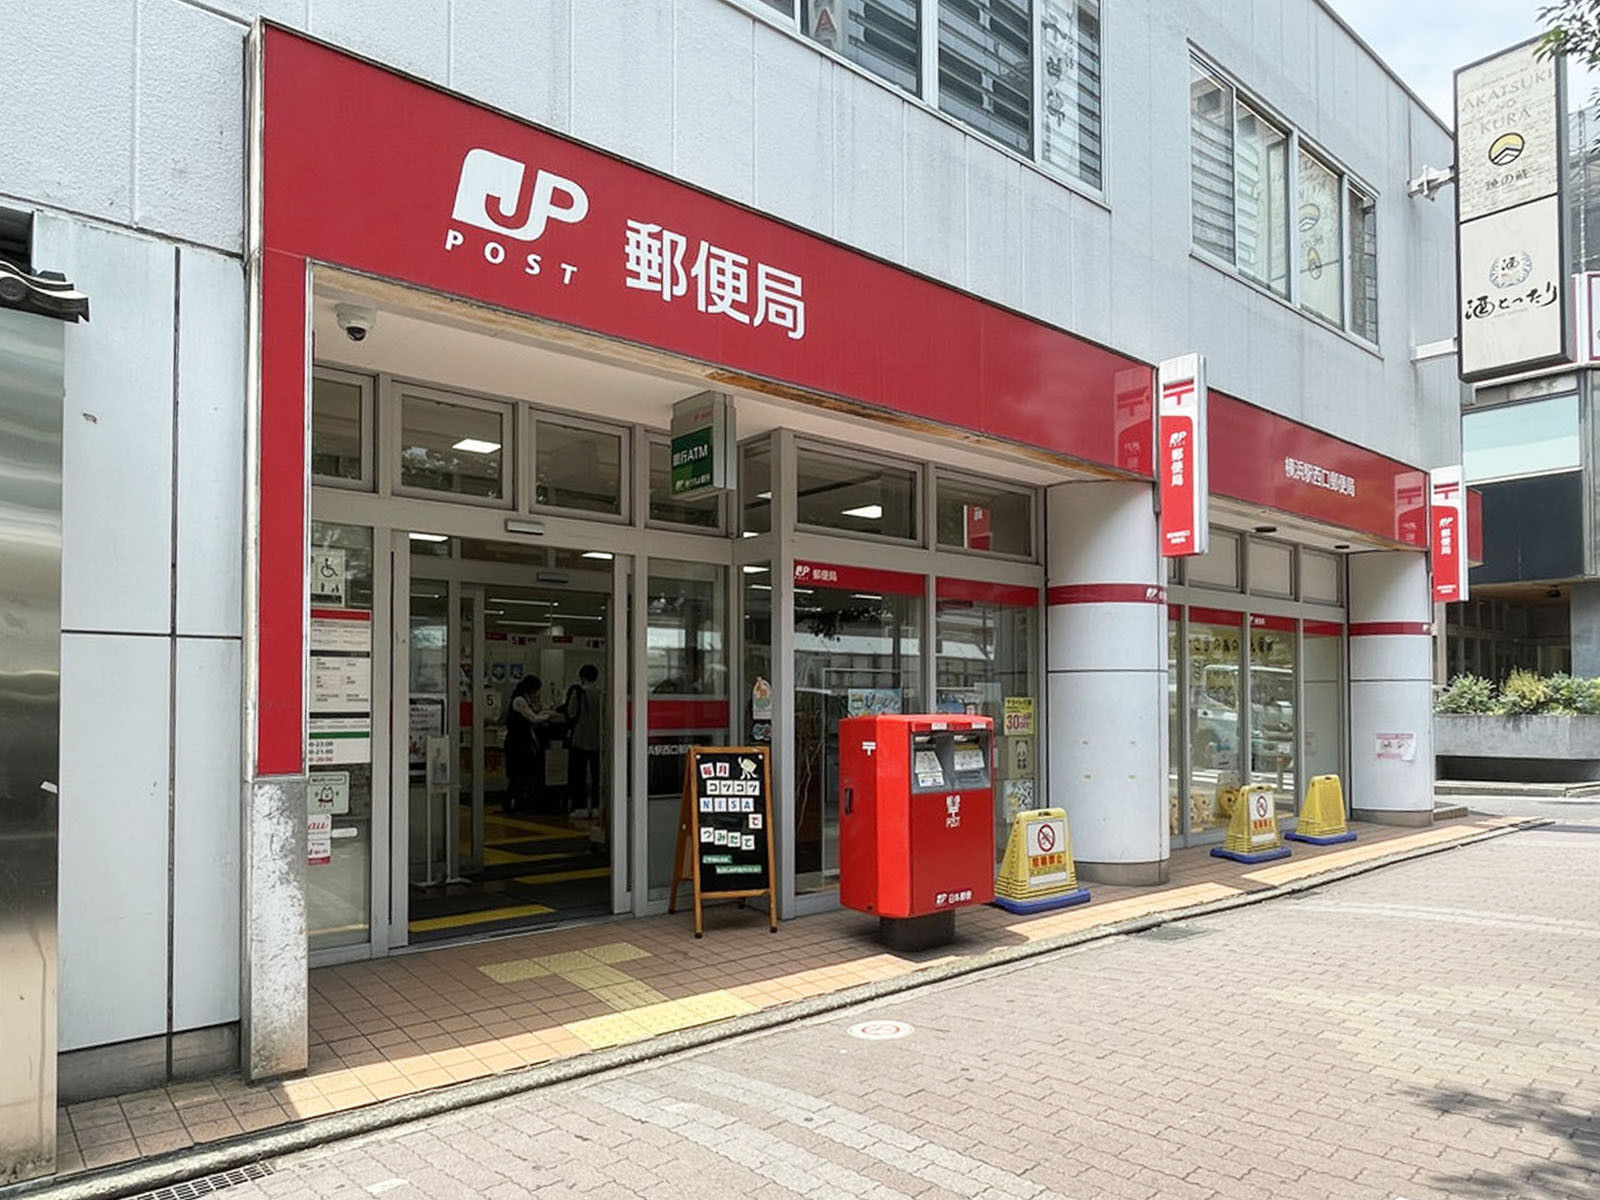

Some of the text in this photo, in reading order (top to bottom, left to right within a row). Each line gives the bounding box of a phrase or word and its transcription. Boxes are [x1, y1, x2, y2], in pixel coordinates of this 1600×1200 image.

[1480, 108, 1532, 134] KURA
[445, 229, 578, 286] POST
[624, 219, 806, 341] 郵便局
[709, 783, 757, 792] コツコツ
[703, 800, 751, 809] NISA
[308, 821, 328, 830] au
[703, 830, 753, 848] つみたて
